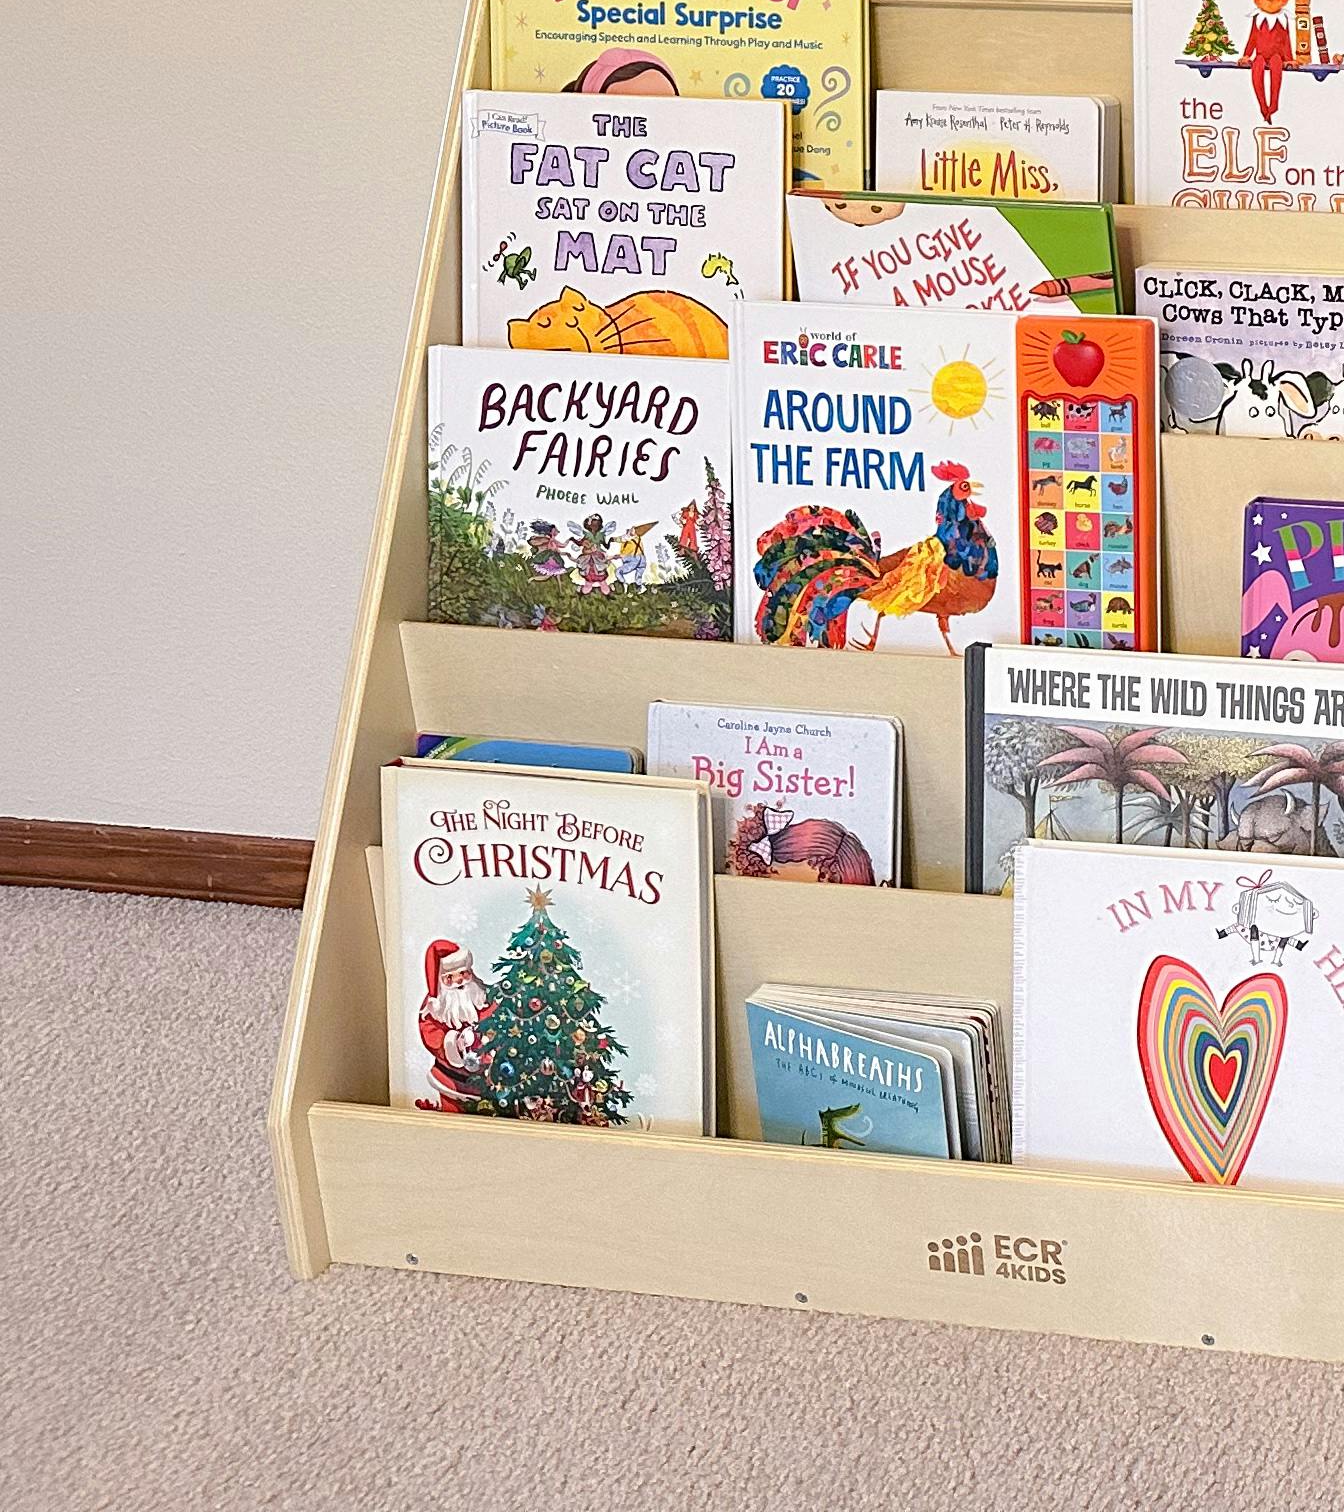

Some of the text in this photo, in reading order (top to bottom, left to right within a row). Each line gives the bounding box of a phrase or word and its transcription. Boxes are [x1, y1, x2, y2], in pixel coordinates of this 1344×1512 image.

[577, 0, 782, 34] Special Surprise
[535, 30, 823, 49] Encouraging Speech and Learning Through Play and Music
[777, 84, 795, 96] 20
[1180, 98, 1224, 120] the
[592, 114, 647, 137] THE
[511, 143, 735, 192] FAT CAT
[921, 148, 1059, 198] Little Miss,
[1181, 125, 1290, 184] ELF
[1285, 167, 1315, 186] on
[535, 197, 706, 227] SAT ON THE
[554, 231, 677, 276] MAT
[832, 218, 982, 296] IF YOU GIVE
[893, 286, 910, 306] A
[913, 253, 1006, 306] MOUSE
[1229, 281, 1315, 304] CLACK,
[1162, 304, 1223, 324] Cows
[1230, 307, 1289, 327] That
[810, 330, 857, 341] world of
[837, 342, 903, 371] CARLE
[479, 380, 699, 436] BACKYARD
[763, 389, 912, 435] AROUND
[513, 430, 680, 482] FAIRIES
[750, 443, 926, 493] THE FARM
[536, 484, 639, 505] PHOEBE WAHL
[1008, 667, 1090, 709] WHERE
[1097, 673, 1141, 712] THE
[1150, 678, 1208, 717] WILD
[1216, 681, 1304, 724] THINGS
[717, 718, 759, 732] Caroline
[795, 724, 832, 737] Church
[745, 737, 803, 760] I Am a
[692, 756, 855, 798] Big Sister!
[414, 837, 664, 905] CHRISTMAS
[1106, 890, 1153, 934] IN
[1159, 881, 1224, 914] MY
[764, 1020, 923, 1093] ALPHABREATHS
[994, 1235, 1062, 1265] ECR
[996, 1262, 1067, 1284] 4KIDS
